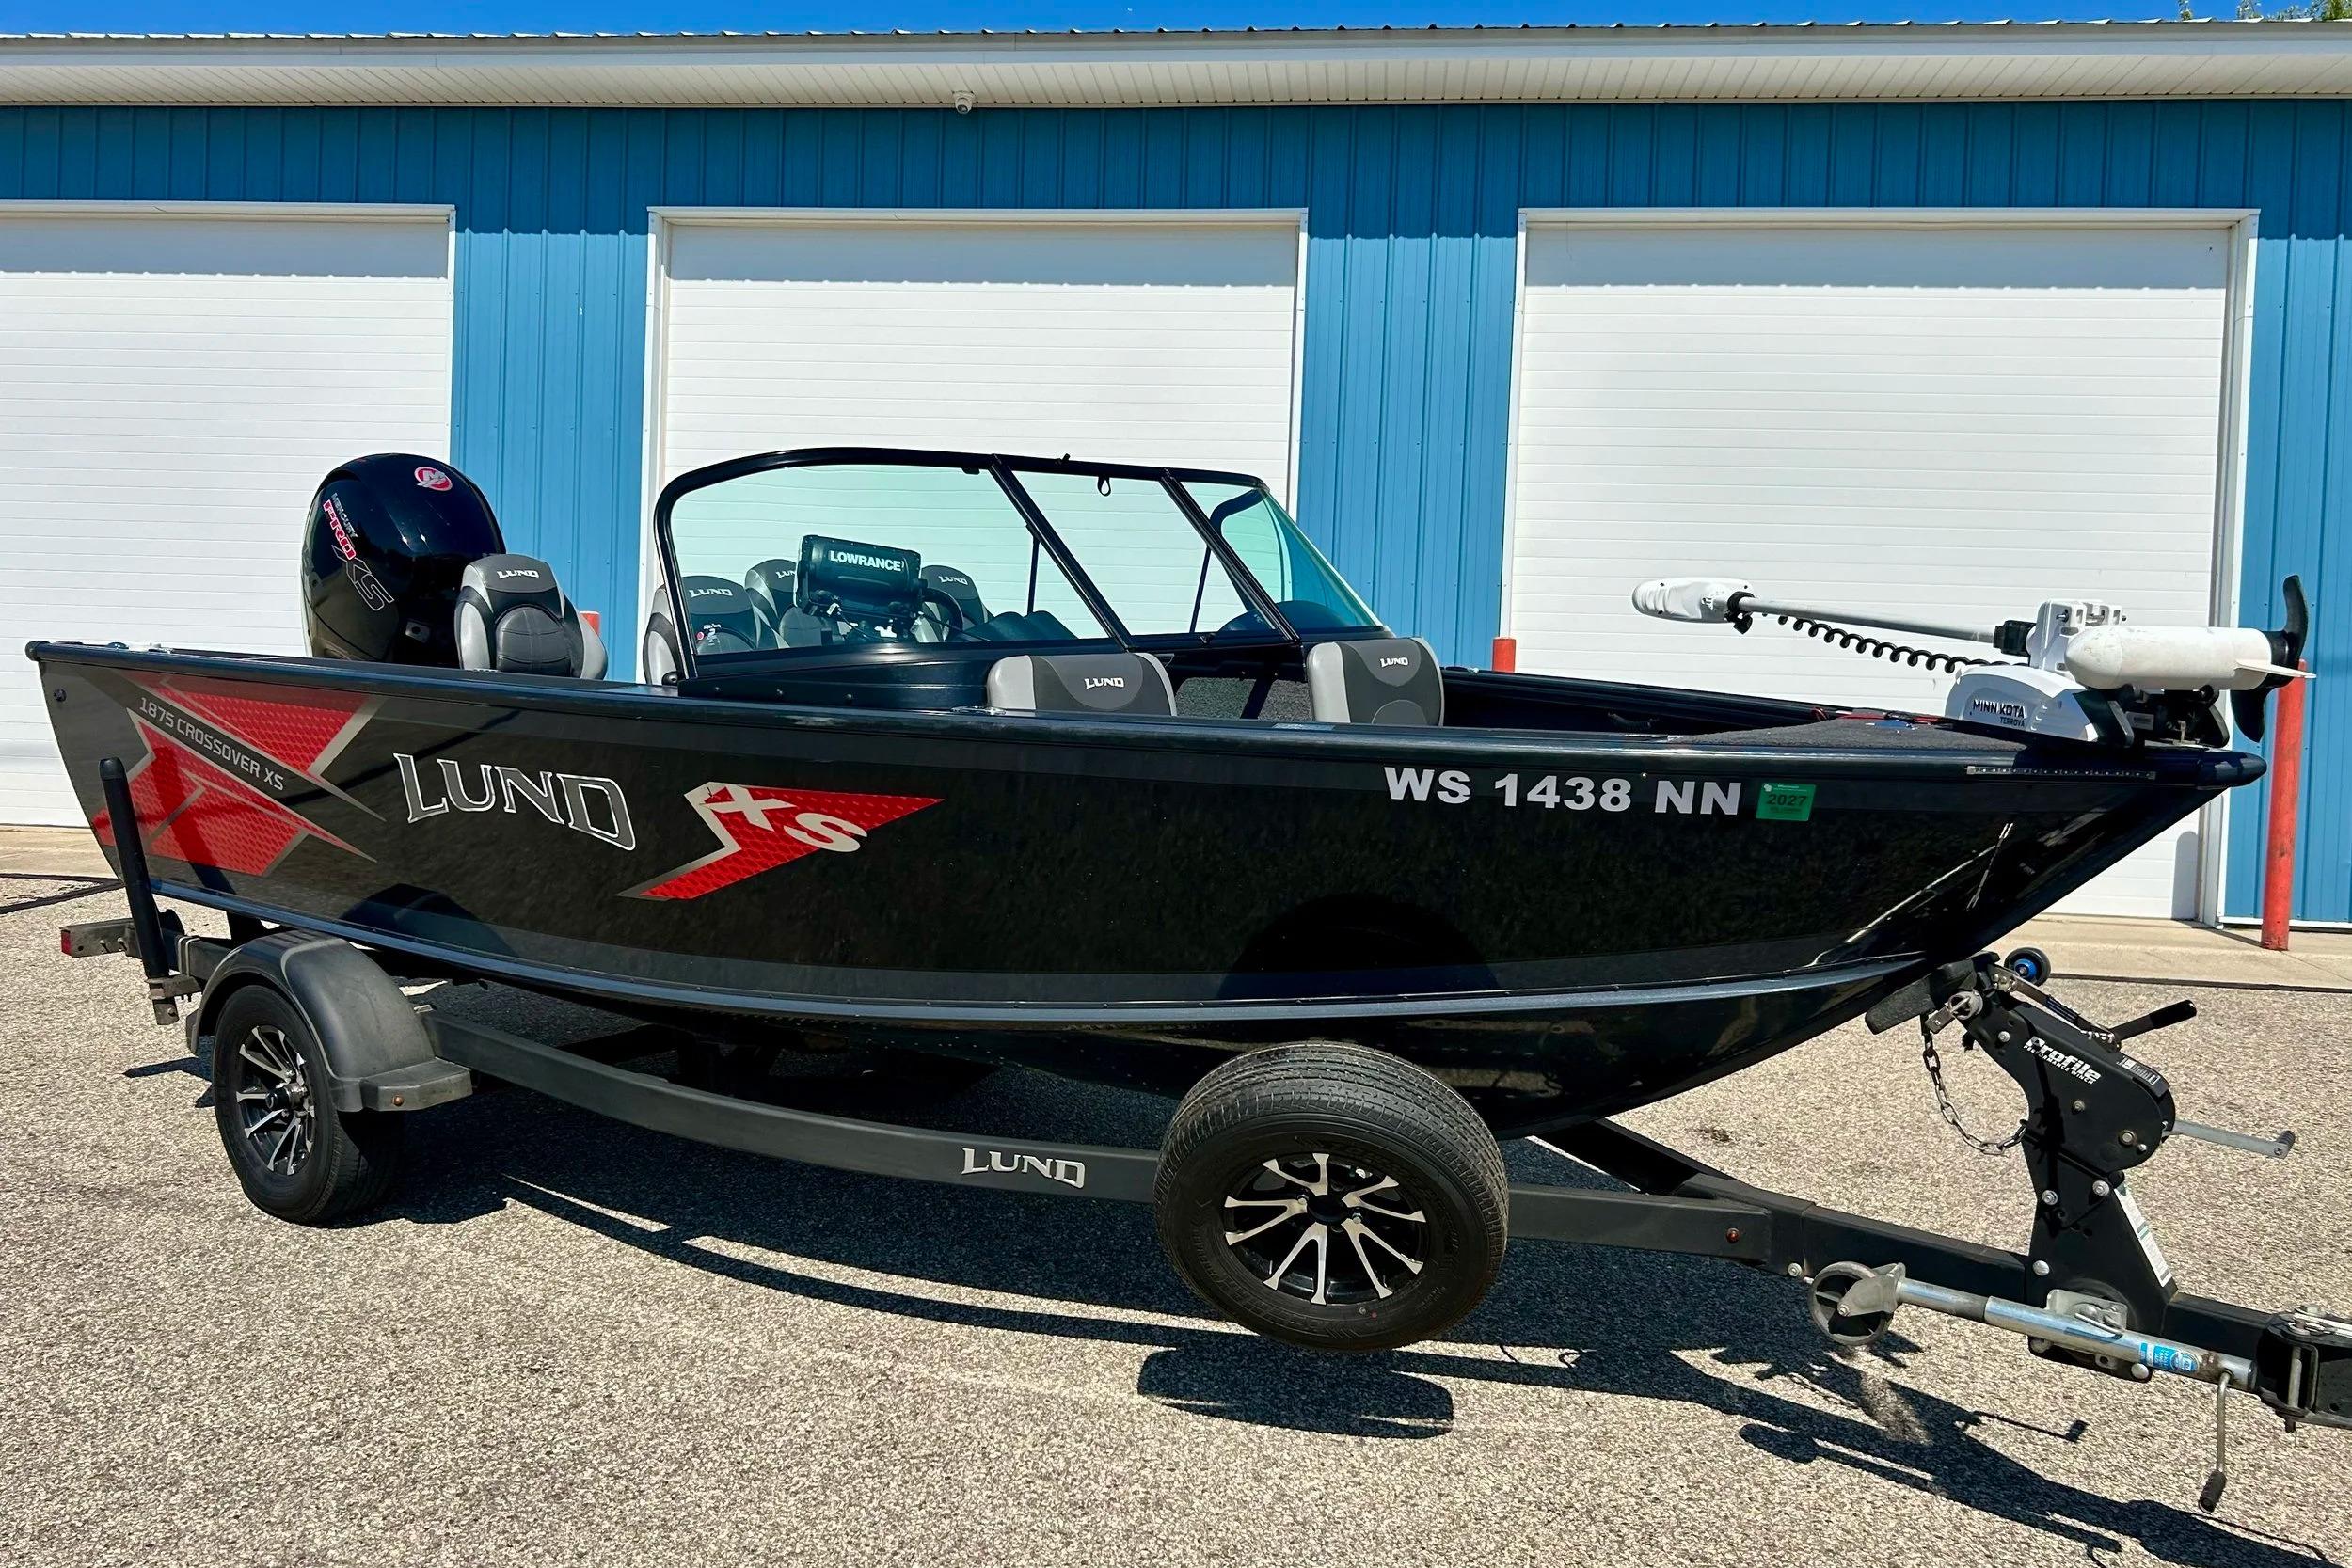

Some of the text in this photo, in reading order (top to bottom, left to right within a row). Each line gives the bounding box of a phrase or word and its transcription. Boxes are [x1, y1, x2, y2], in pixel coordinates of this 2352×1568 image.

[331, 493, 358, 537] MERCURY
[323, 499, 356, 560] PRO
[830, 550, 904, 571] LOWRANCE
[331, 545, 394, 610] XS
[497, 570, 539, 578] LUND
[776, 570, 797, 578] LUN
[939, 575, 968, 586] LUND
[689, 588, 733, 598] LUND
[1380, 657, 1409, 668] LUND
[1085, 676, 1124, 689] LUND
[1973, 699, 2026, 718] MINN KOTA
[2000, 716, 2025, 726] TERROVA
[139, 697, 284, 791] 1875 CROSSOVER XS
[1384, 767, 1742, 815] WS 1438 NN
[1766, 794, 1807, 806] 2027
[393, 752, 636, 851] LUND
[700, 784, 868, 853] XS
[2025, 1036, 2102, 1080] Profile
[2071, 1070, 2096, 1085] WINCH
[961, 1148, 1085, 1189] LUND
